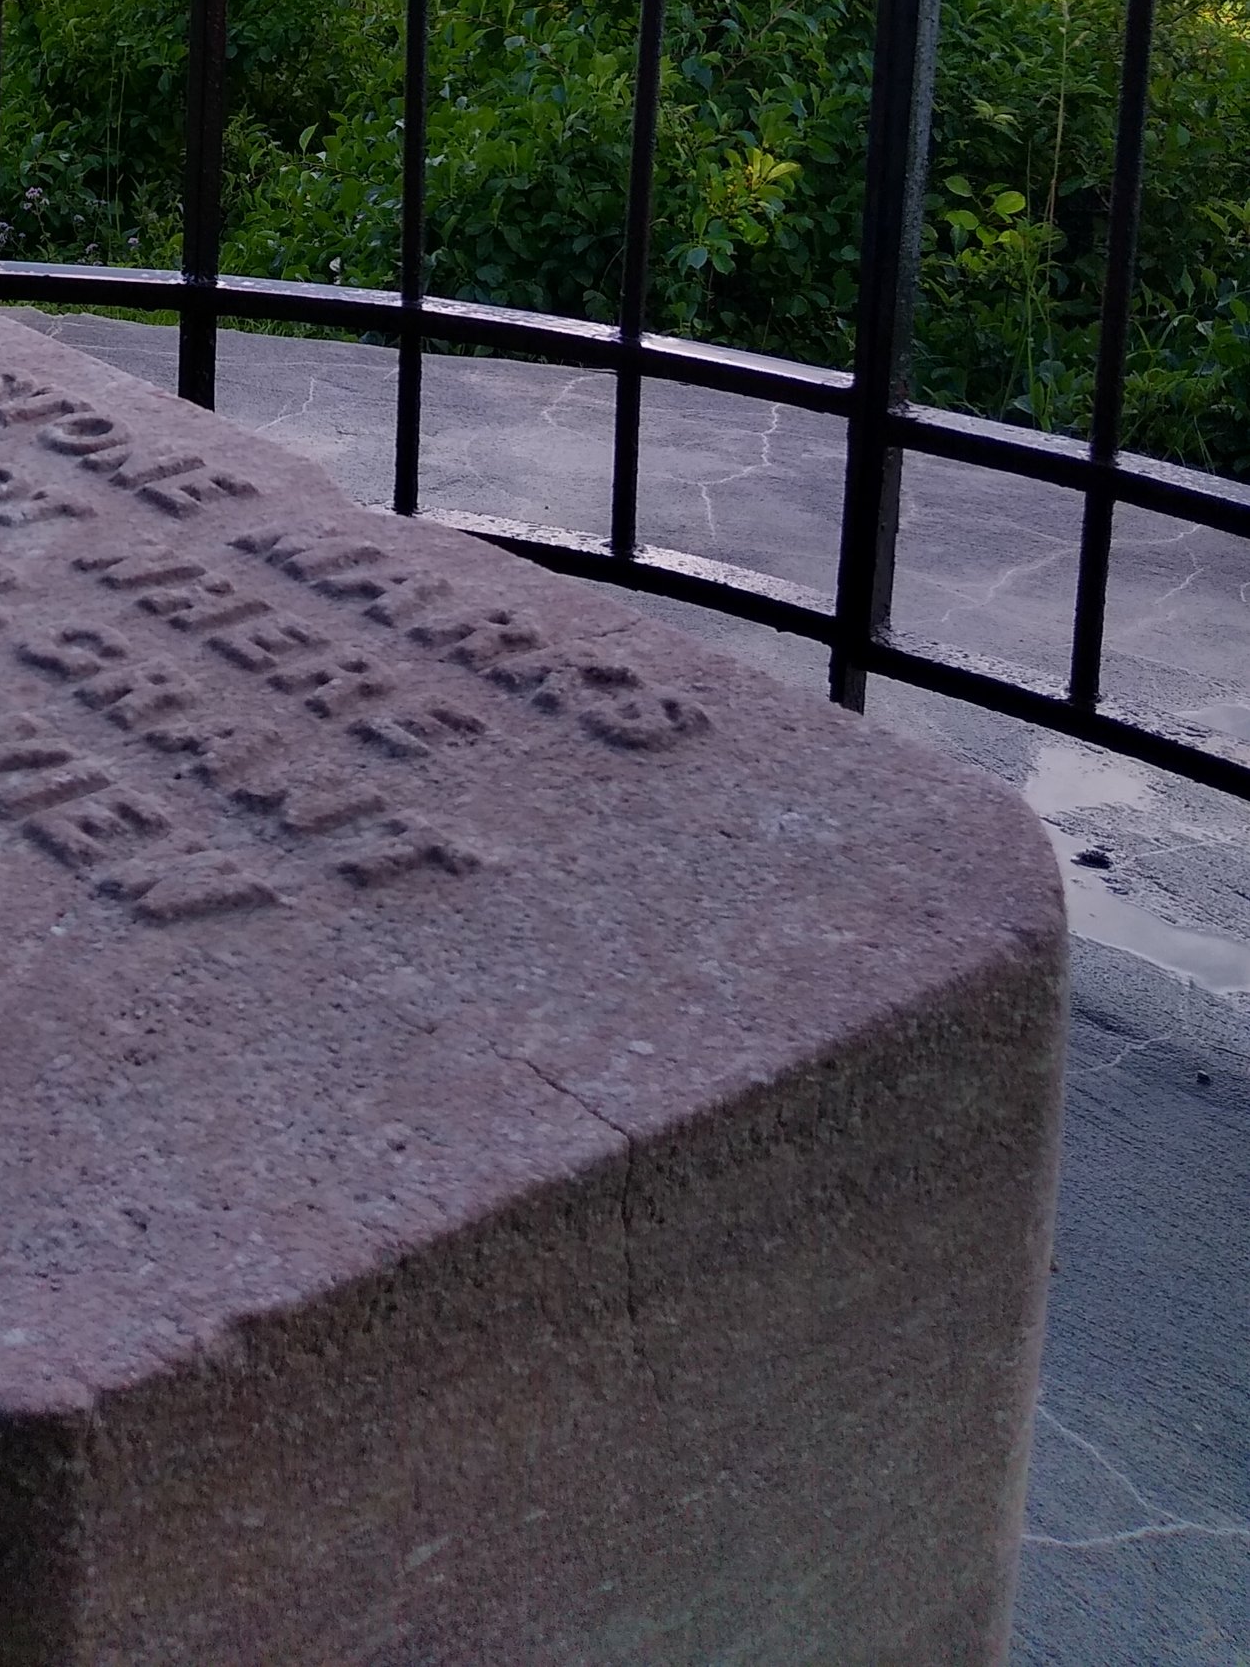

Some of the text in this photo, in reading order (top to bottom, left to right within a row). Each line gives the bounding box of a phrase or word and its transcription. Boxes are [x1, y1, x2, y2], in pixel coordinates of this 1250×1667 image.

[70, 540, 488, 760] WHERE
[228, 532, 716, 750] MARKS
[13, 626, 483, 890] GRANT
